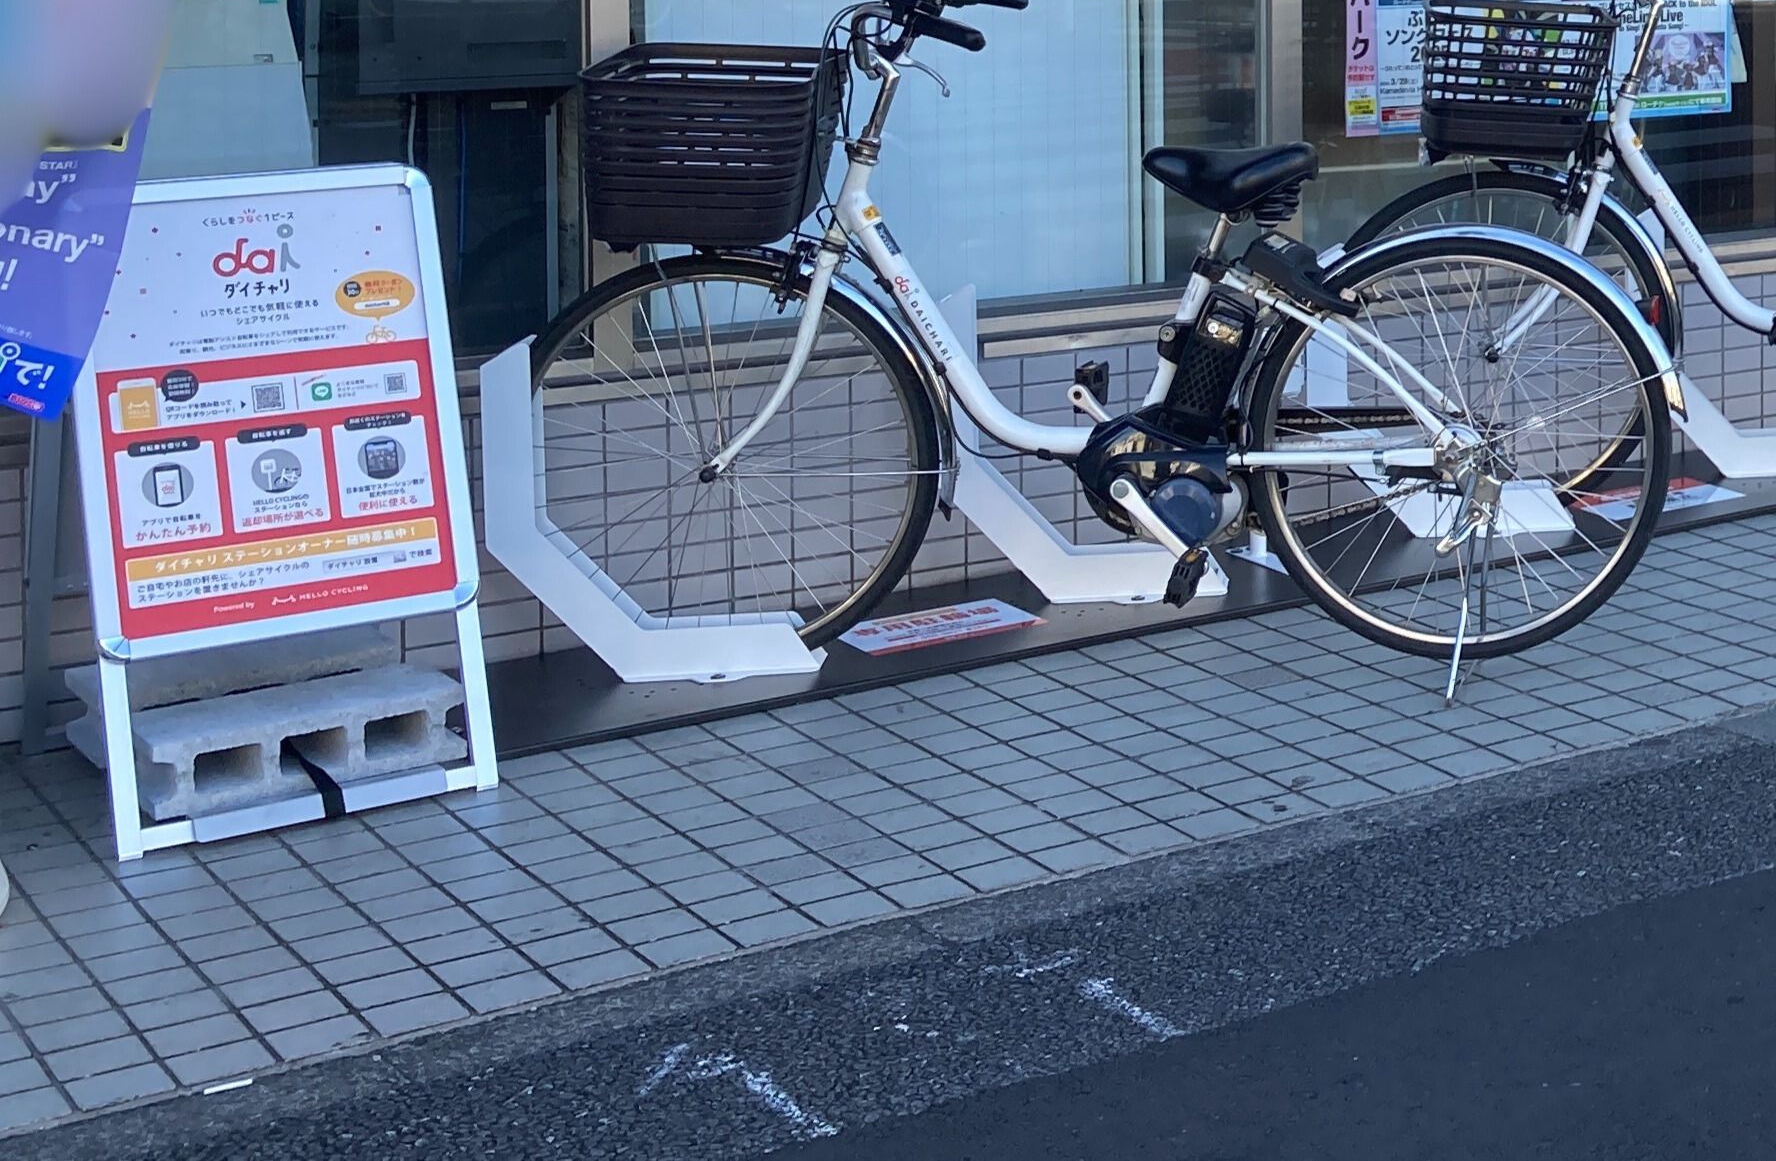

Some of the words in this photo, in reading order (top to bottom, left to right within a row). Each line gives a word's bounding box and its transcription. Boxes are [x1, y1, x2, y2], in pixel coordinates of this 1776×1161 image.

[212, 223, 301, 278] dai
[223, 277, 291, 300] ダイチャリ
[235, 314, 291, 326] シェアサイクル
[908, 298, 955, 364] DAICHARI
[358, 494, 418, 512] 便利に使える
[241, 507, 324, 528] 返却場所が選べる
[135, 521, 213, 543] かんたん予約
[154, 554, 217, 574] ダイチャリ
[213, 602, 244, 615] Powered
[245, 600, 256, 613] by
